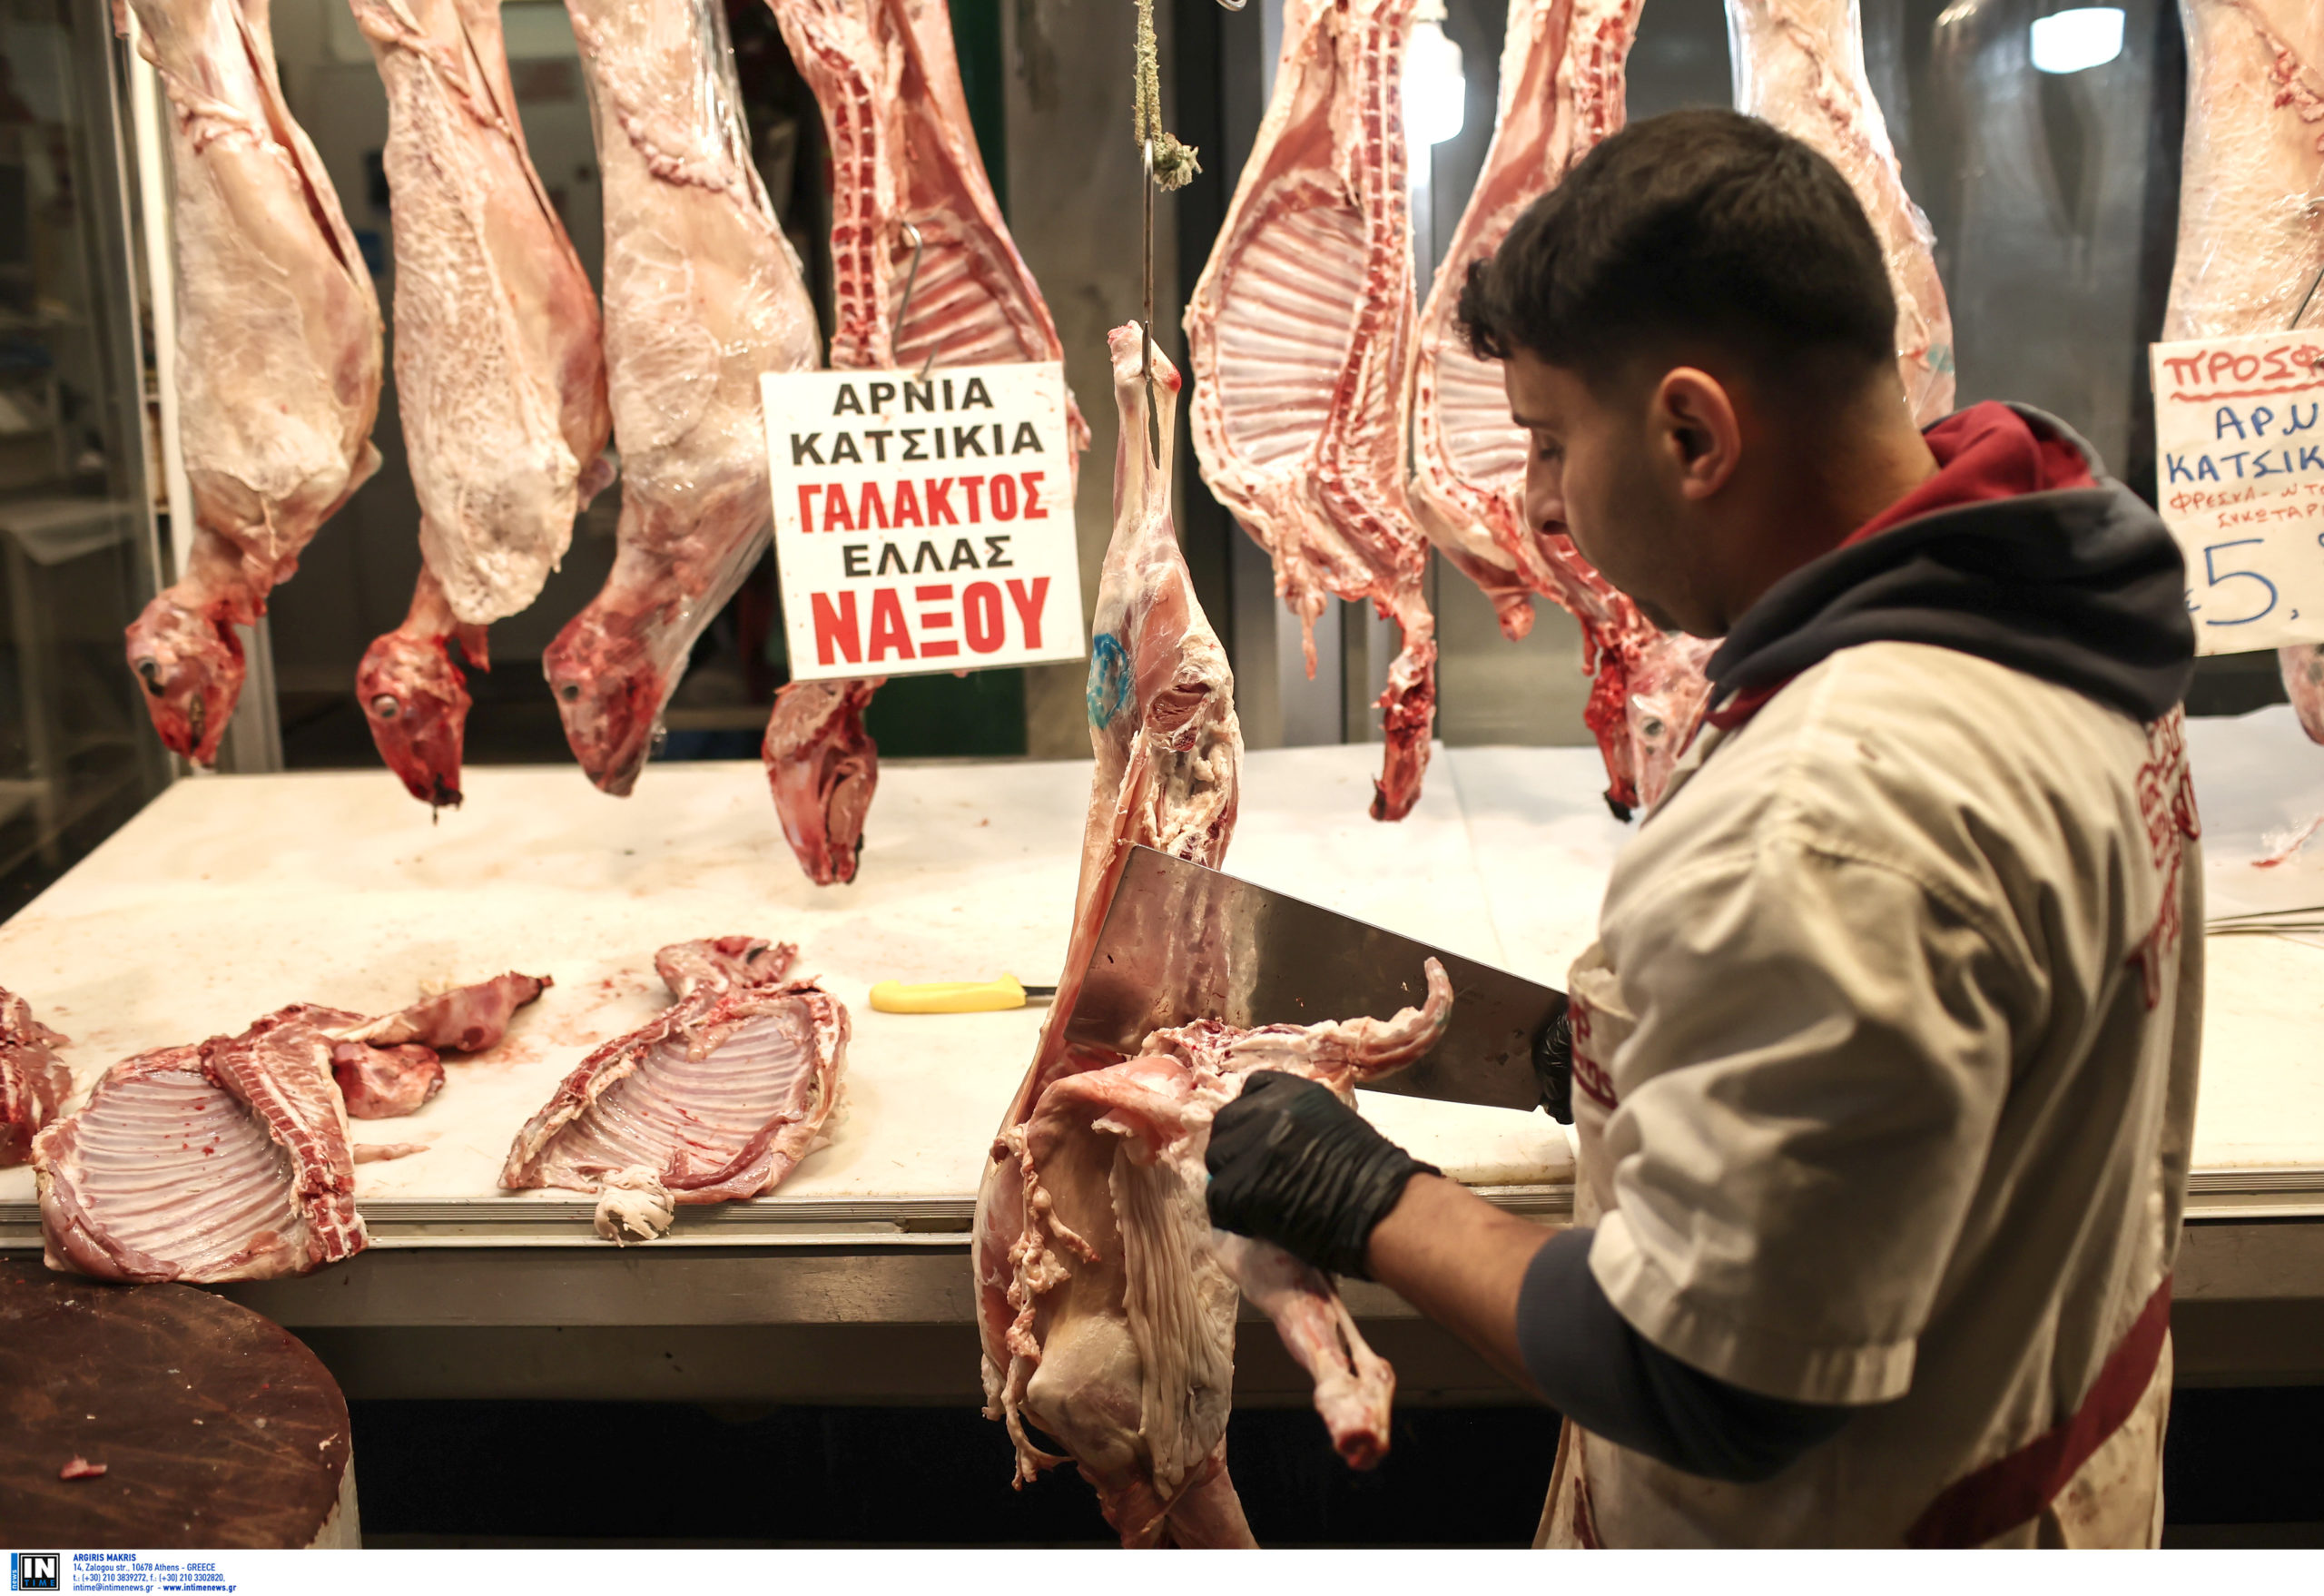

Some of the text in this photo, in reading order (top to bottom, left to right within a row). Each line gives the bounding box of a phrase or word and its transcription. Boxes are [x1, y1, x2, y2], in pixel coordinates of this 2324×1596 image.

[832, 377, 994, 416] ΑΡΝΙΑ
[790, 421, 1045, 467] ΚΑΤΣΙΚΙΑ
[797, 470, 1049, 534] ΓΑΛΑΚΤΟΣ
[842, 535, 1014, 578] ΕΛΛΑΣ
[811, 576, 1051, 665] ΝΑΞΟΥ
